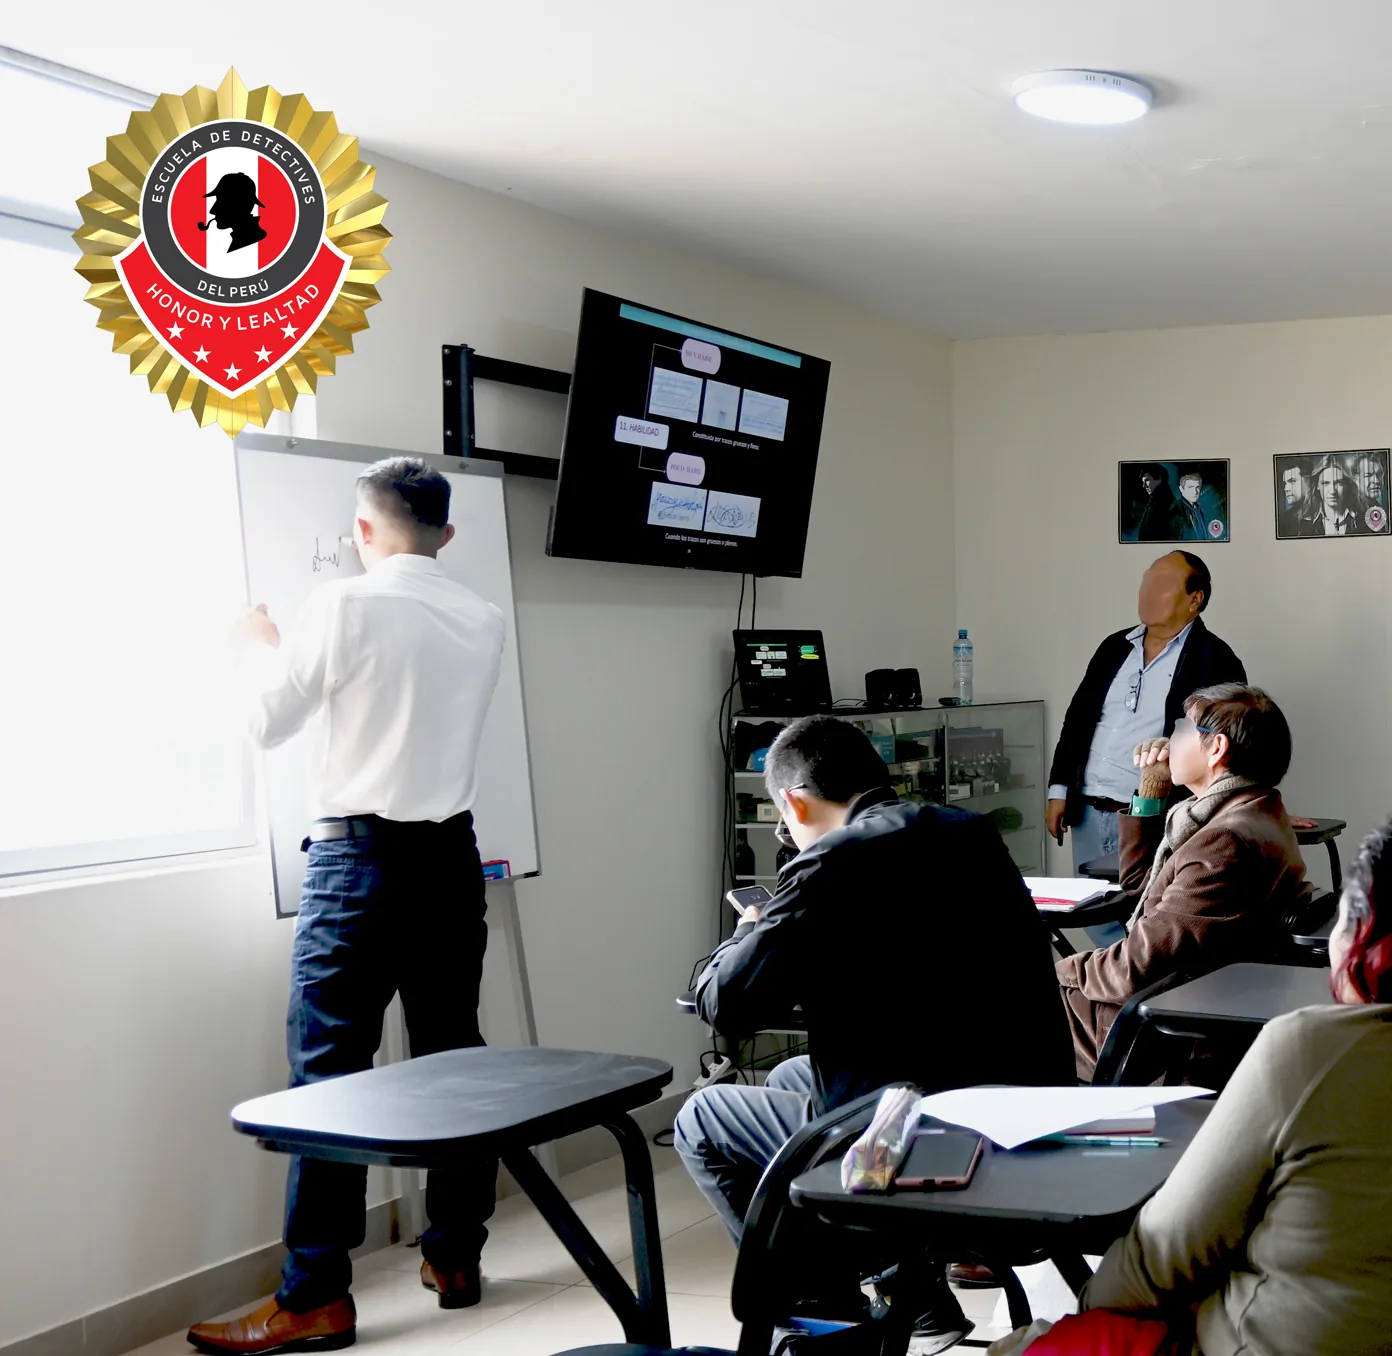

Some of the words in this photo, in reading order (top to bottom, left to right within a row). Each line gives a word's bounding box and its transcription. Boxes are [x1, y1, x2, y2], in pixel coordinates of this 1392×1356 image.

[620, 421, 628, 431] 11.
[629, 424, 660, 437] HABILIDAD
[670, 463, 685, 471] POCO
[665, 533, 681, 541] Cuando
